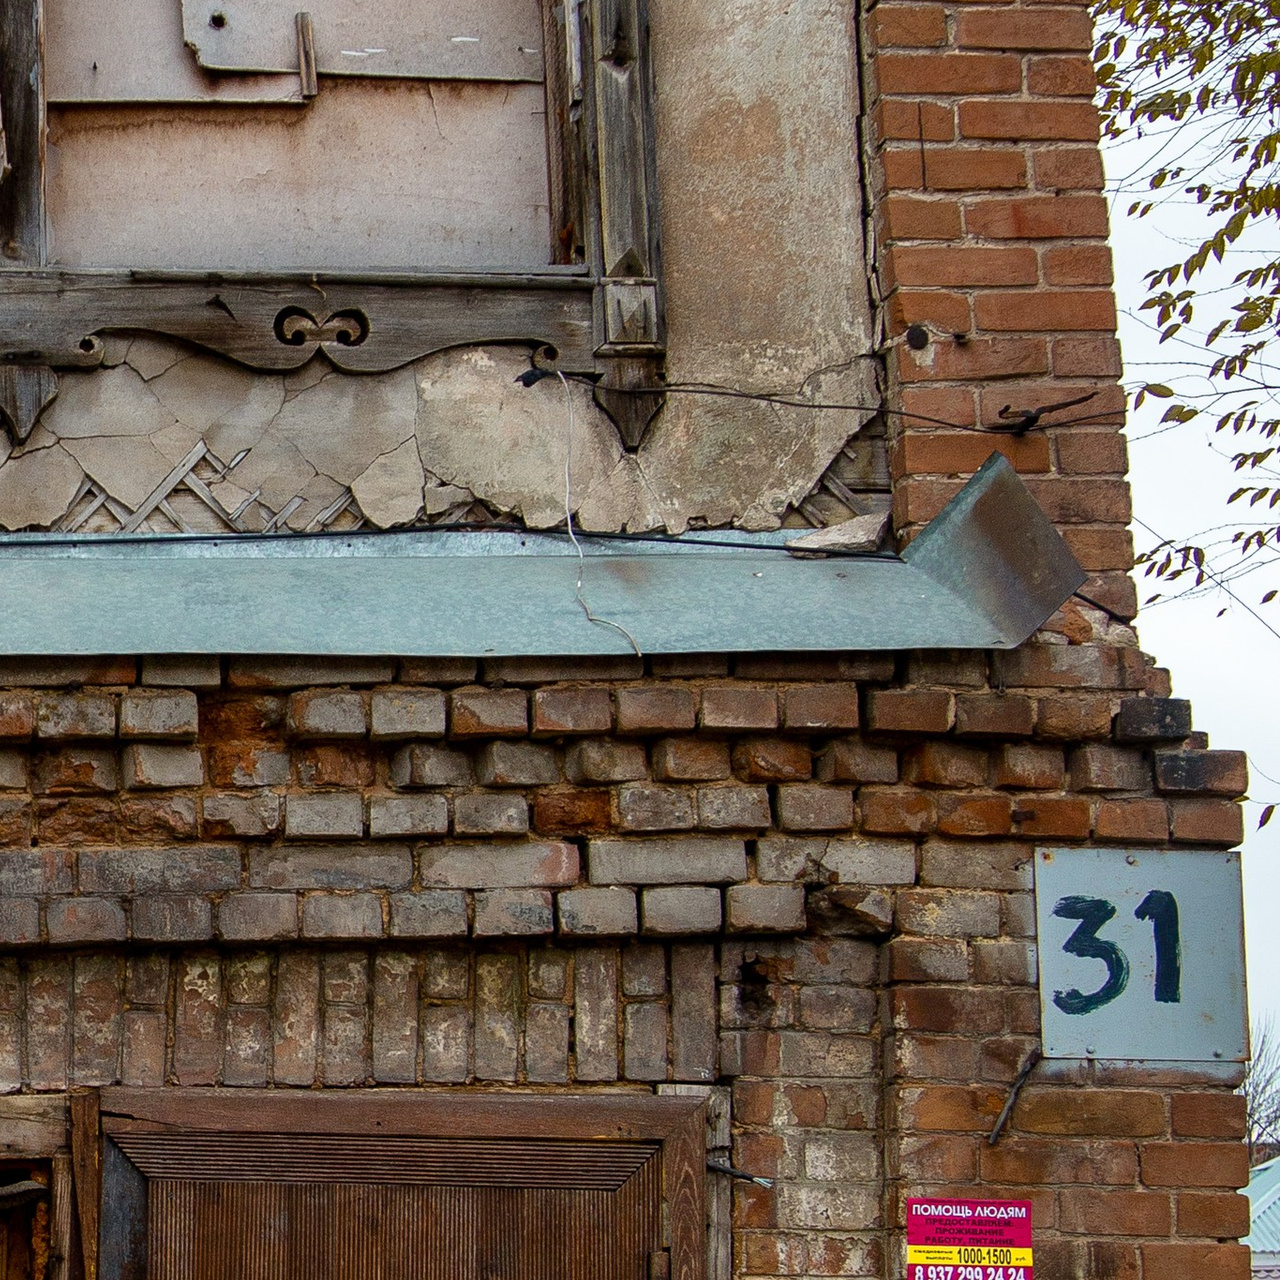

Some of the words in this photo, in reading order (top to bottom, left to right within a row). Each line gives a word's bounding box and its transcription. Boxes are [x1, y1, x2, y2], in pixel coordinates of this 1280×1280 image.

[1050, 889, 1182, 1016] 31
[912, 1204, 973, 1218] ПОМОЩЬ
[974, 1206, 1026, 1219] ЛЮДЯМ
[935, 1227, 1005, 1236] ПРОЖИВАНИЕ
[925, 1236, 966, 1245] РАБОТУ,
[968, 1237, 1015, 1246] ПИТАНИЕ
[957, 1247, 1012, 1265] 1000-1500
